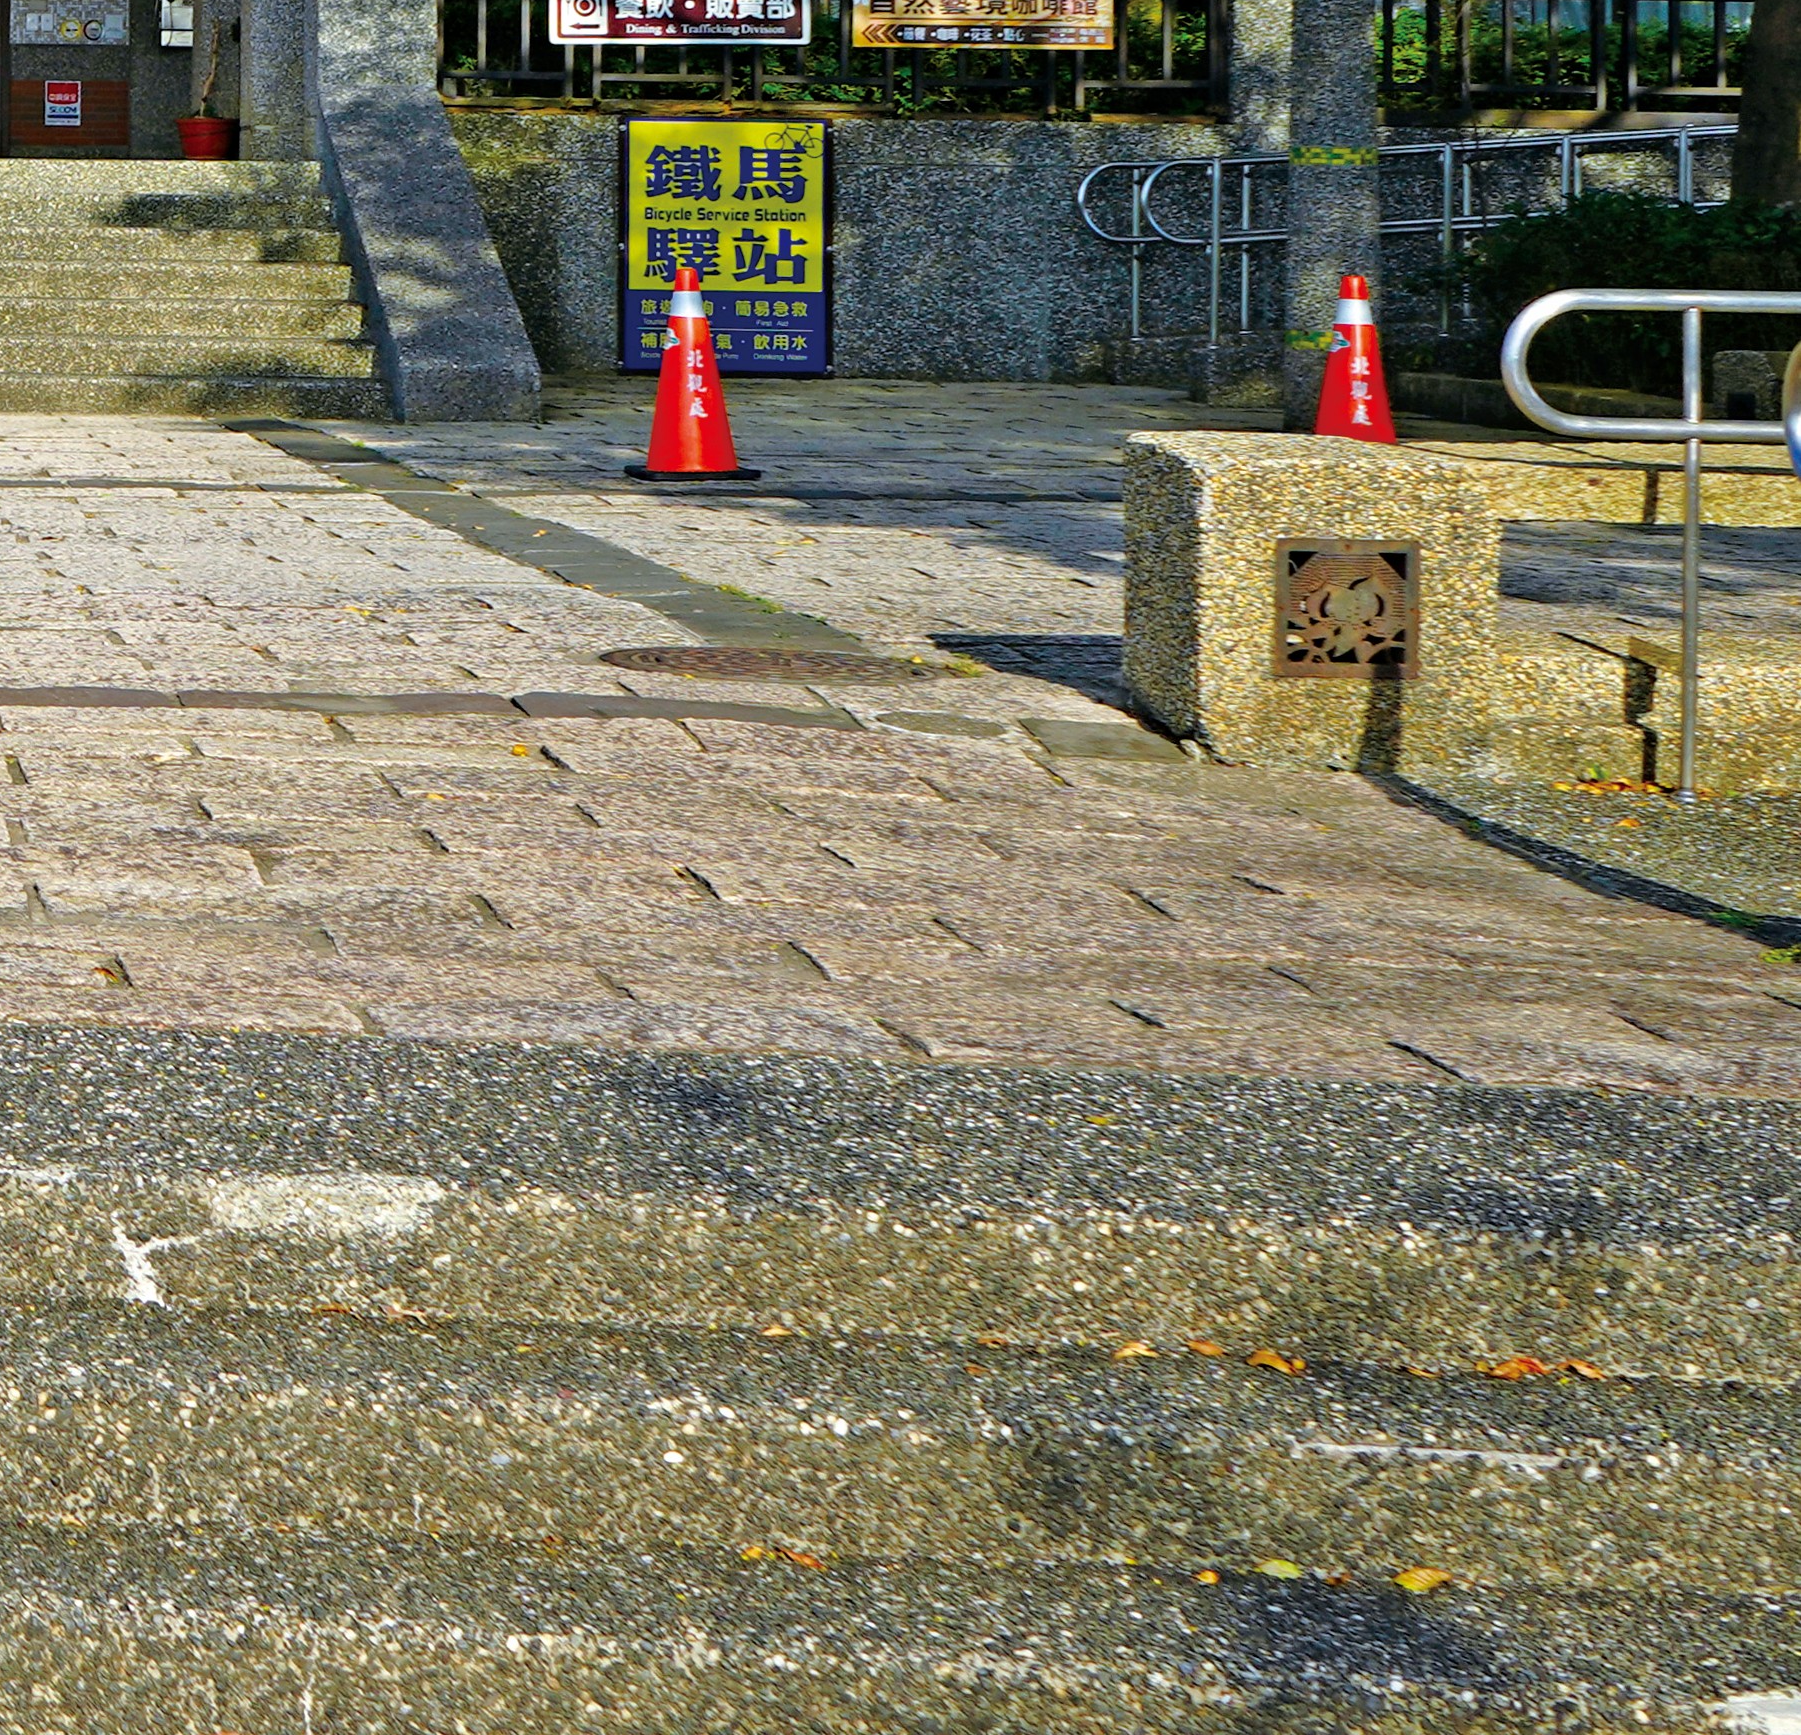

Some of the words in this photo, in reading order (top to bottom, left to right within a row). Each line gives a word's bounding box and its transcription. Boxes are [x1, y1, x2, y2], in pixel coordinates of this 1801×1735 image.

[625, 24, 663, 35] Dining
[665, 24, 677, 34] &
[681, 24, 740, 36] Trafficking
[741, 24, 786, 34] Division
[644, 145, 808, 204] 鐵馬
[644, 207, 693, 222] Bicycle
[697, 207, 750, 222] Service
[754, 208, 807, 222] Station
[643, 227, 808, 285] 驛站
[753, 334, 808, 351] 飲用水
